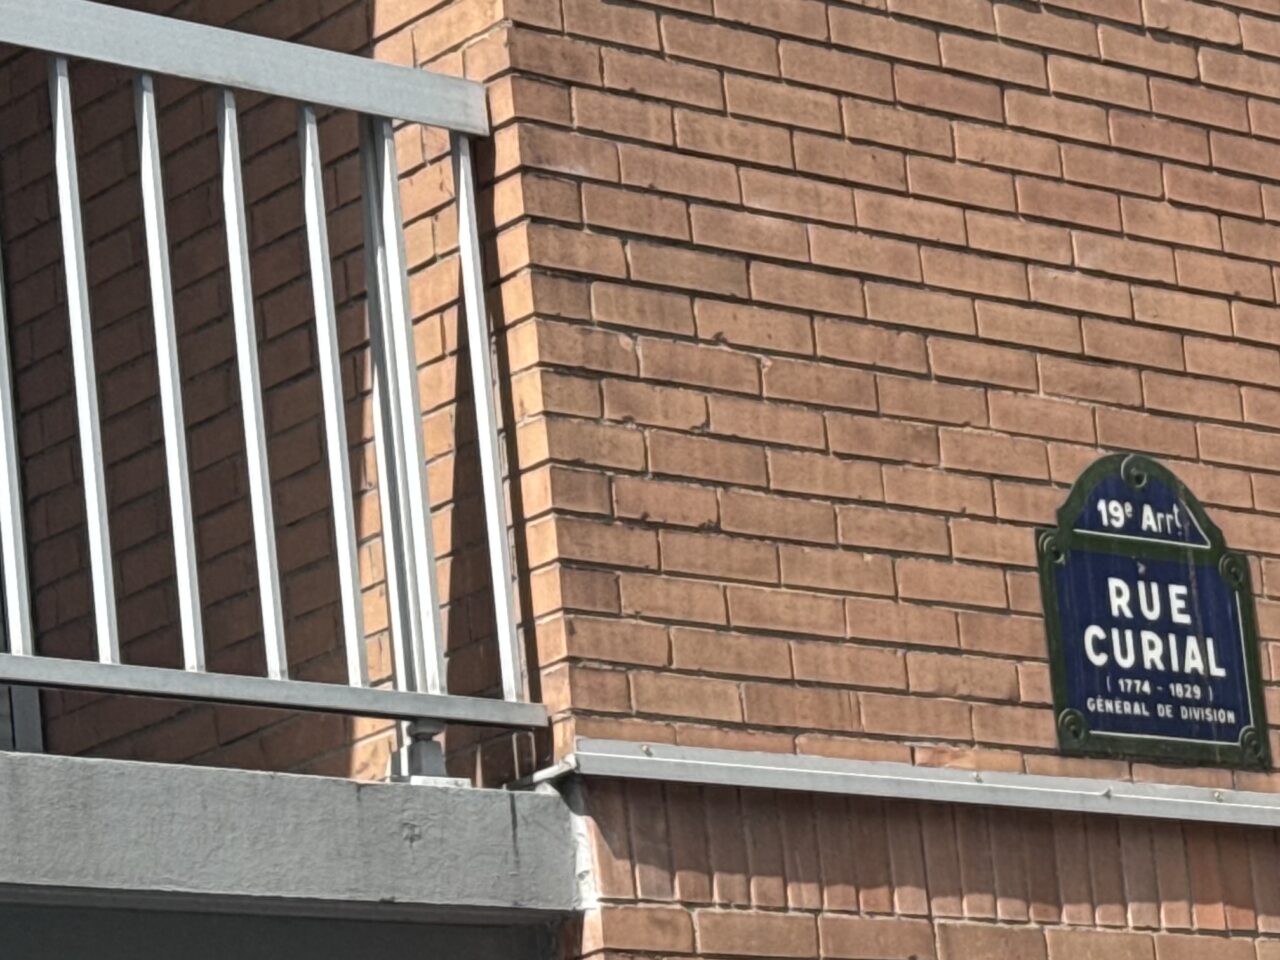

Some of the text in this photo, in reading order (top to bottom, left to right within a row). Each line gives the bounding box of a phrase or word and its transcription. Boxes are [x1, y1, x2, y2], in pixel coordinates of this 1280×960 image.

[1097, 498, 1133, 528] 19e
[1107, 577, 1192, 625] RUE
[1083, 625, 1227, 678] CURIAL
[1156, 703, 1174, 718] DE
[1180, 705, 1236, 724] DIVISION
